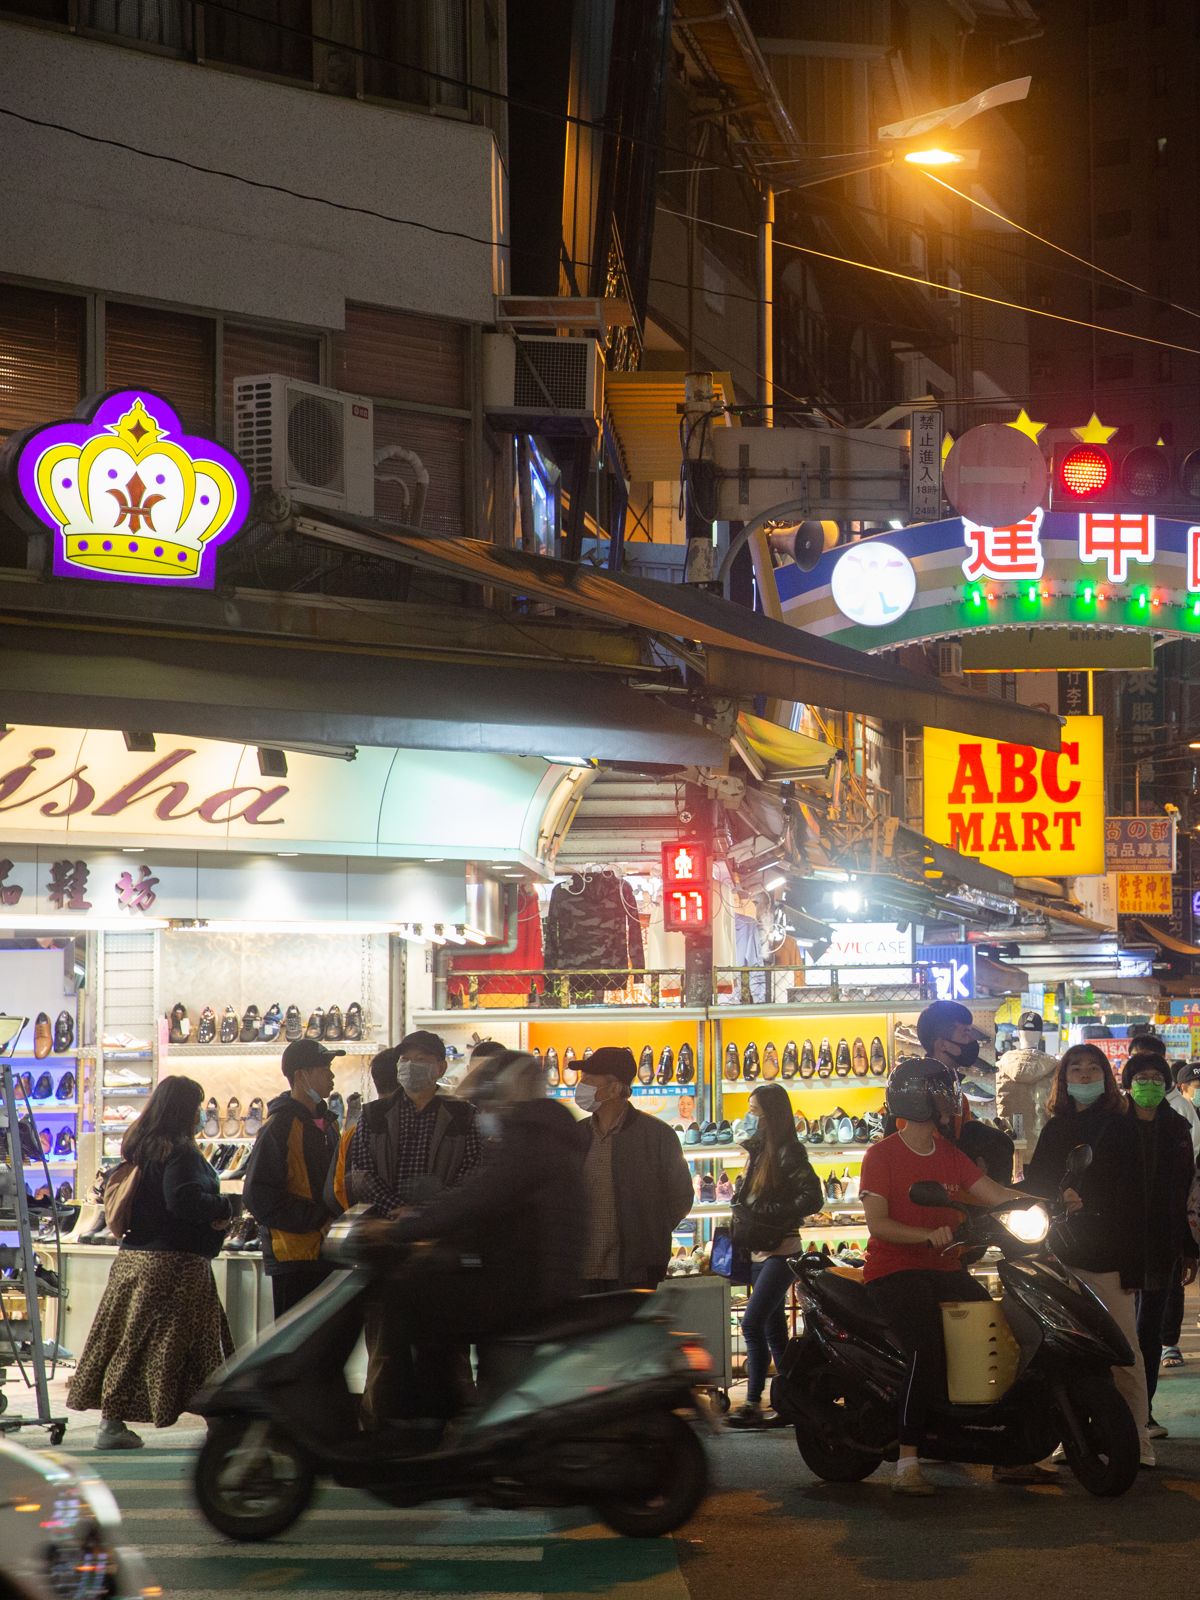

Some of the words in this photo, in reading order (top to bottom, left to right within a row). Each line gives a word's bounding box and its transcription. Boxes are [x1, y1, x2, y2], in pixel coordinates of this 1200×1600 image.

[919, 415, 935, 482] 禁止進入
[1066, 670, 1082, 715] 行李
[0, 729, 290, 825] isha
[948, 741, 1081, 805] ABC
[948, 812, 1081, 852] MART
[672, 892, 703, 921] 77
